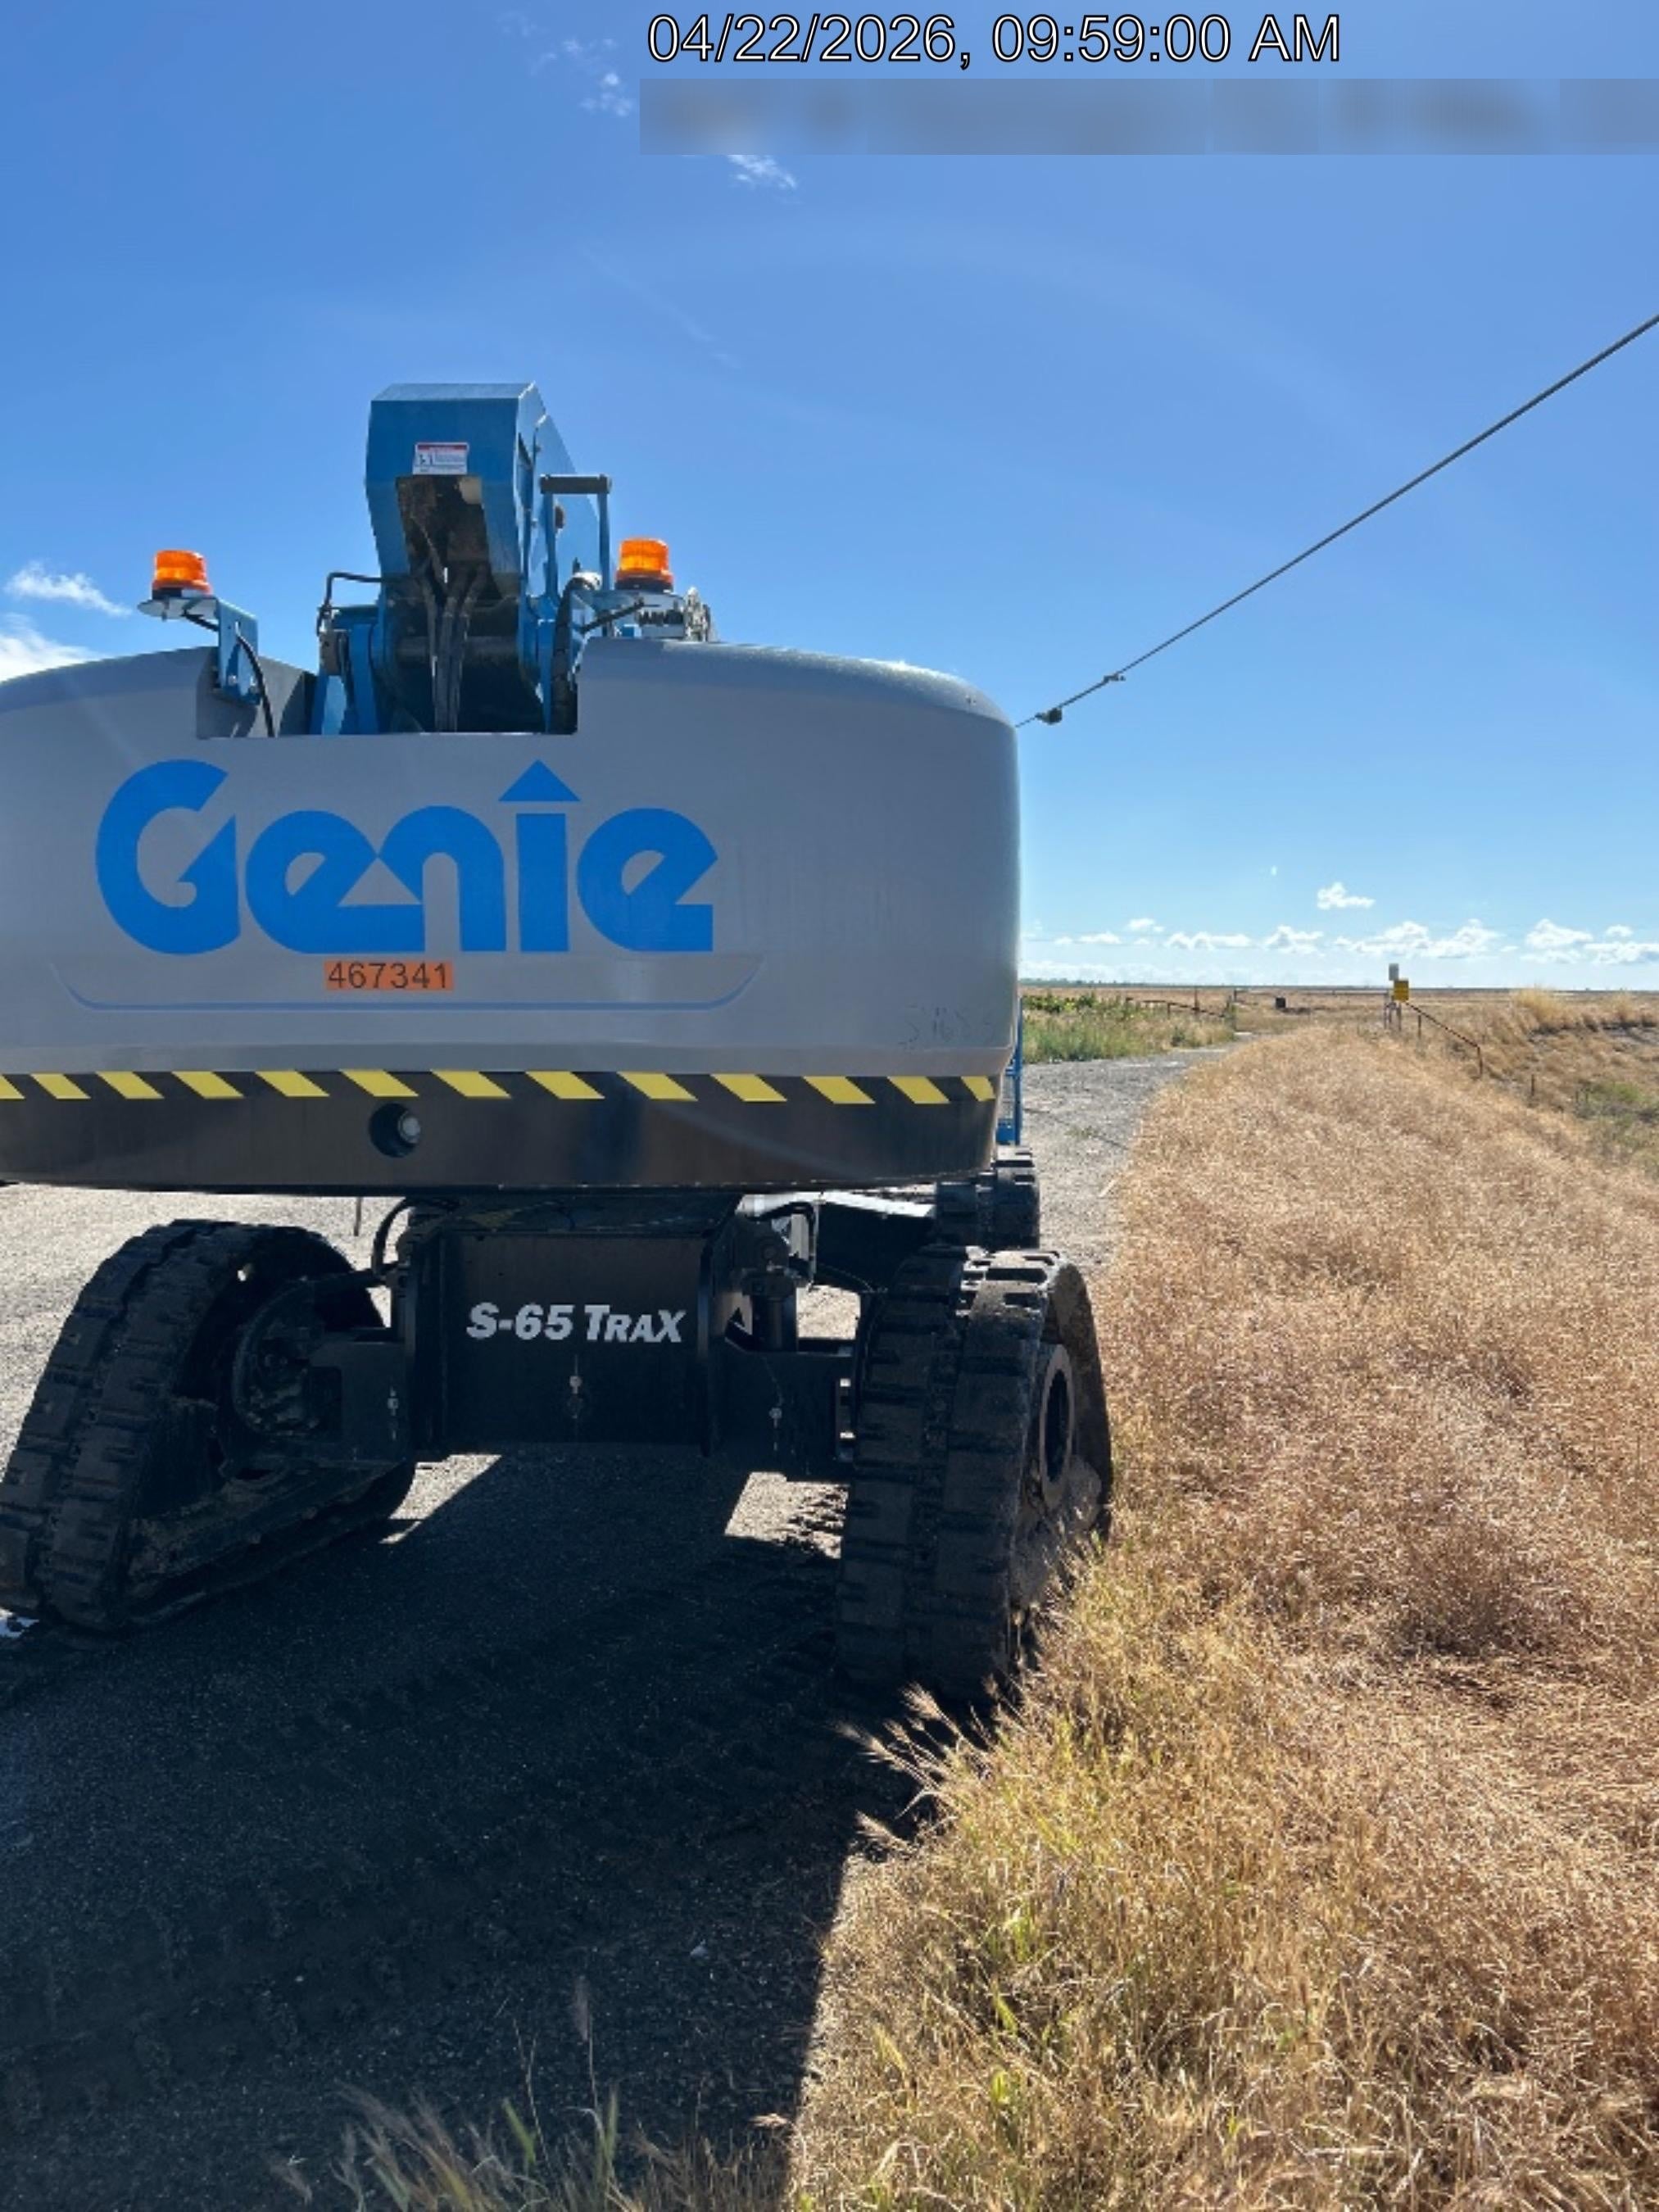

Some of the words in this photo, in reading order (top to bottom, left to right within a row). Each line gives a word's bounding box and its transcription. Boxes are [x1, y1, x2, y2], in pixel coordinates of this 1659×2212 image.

[95, 759, 718, 955] Genie
[328, 961, 446, 989] 467341
[465, 1302, 575, 1341] S-65
[583, 1303, 687, 1343] TRAX
